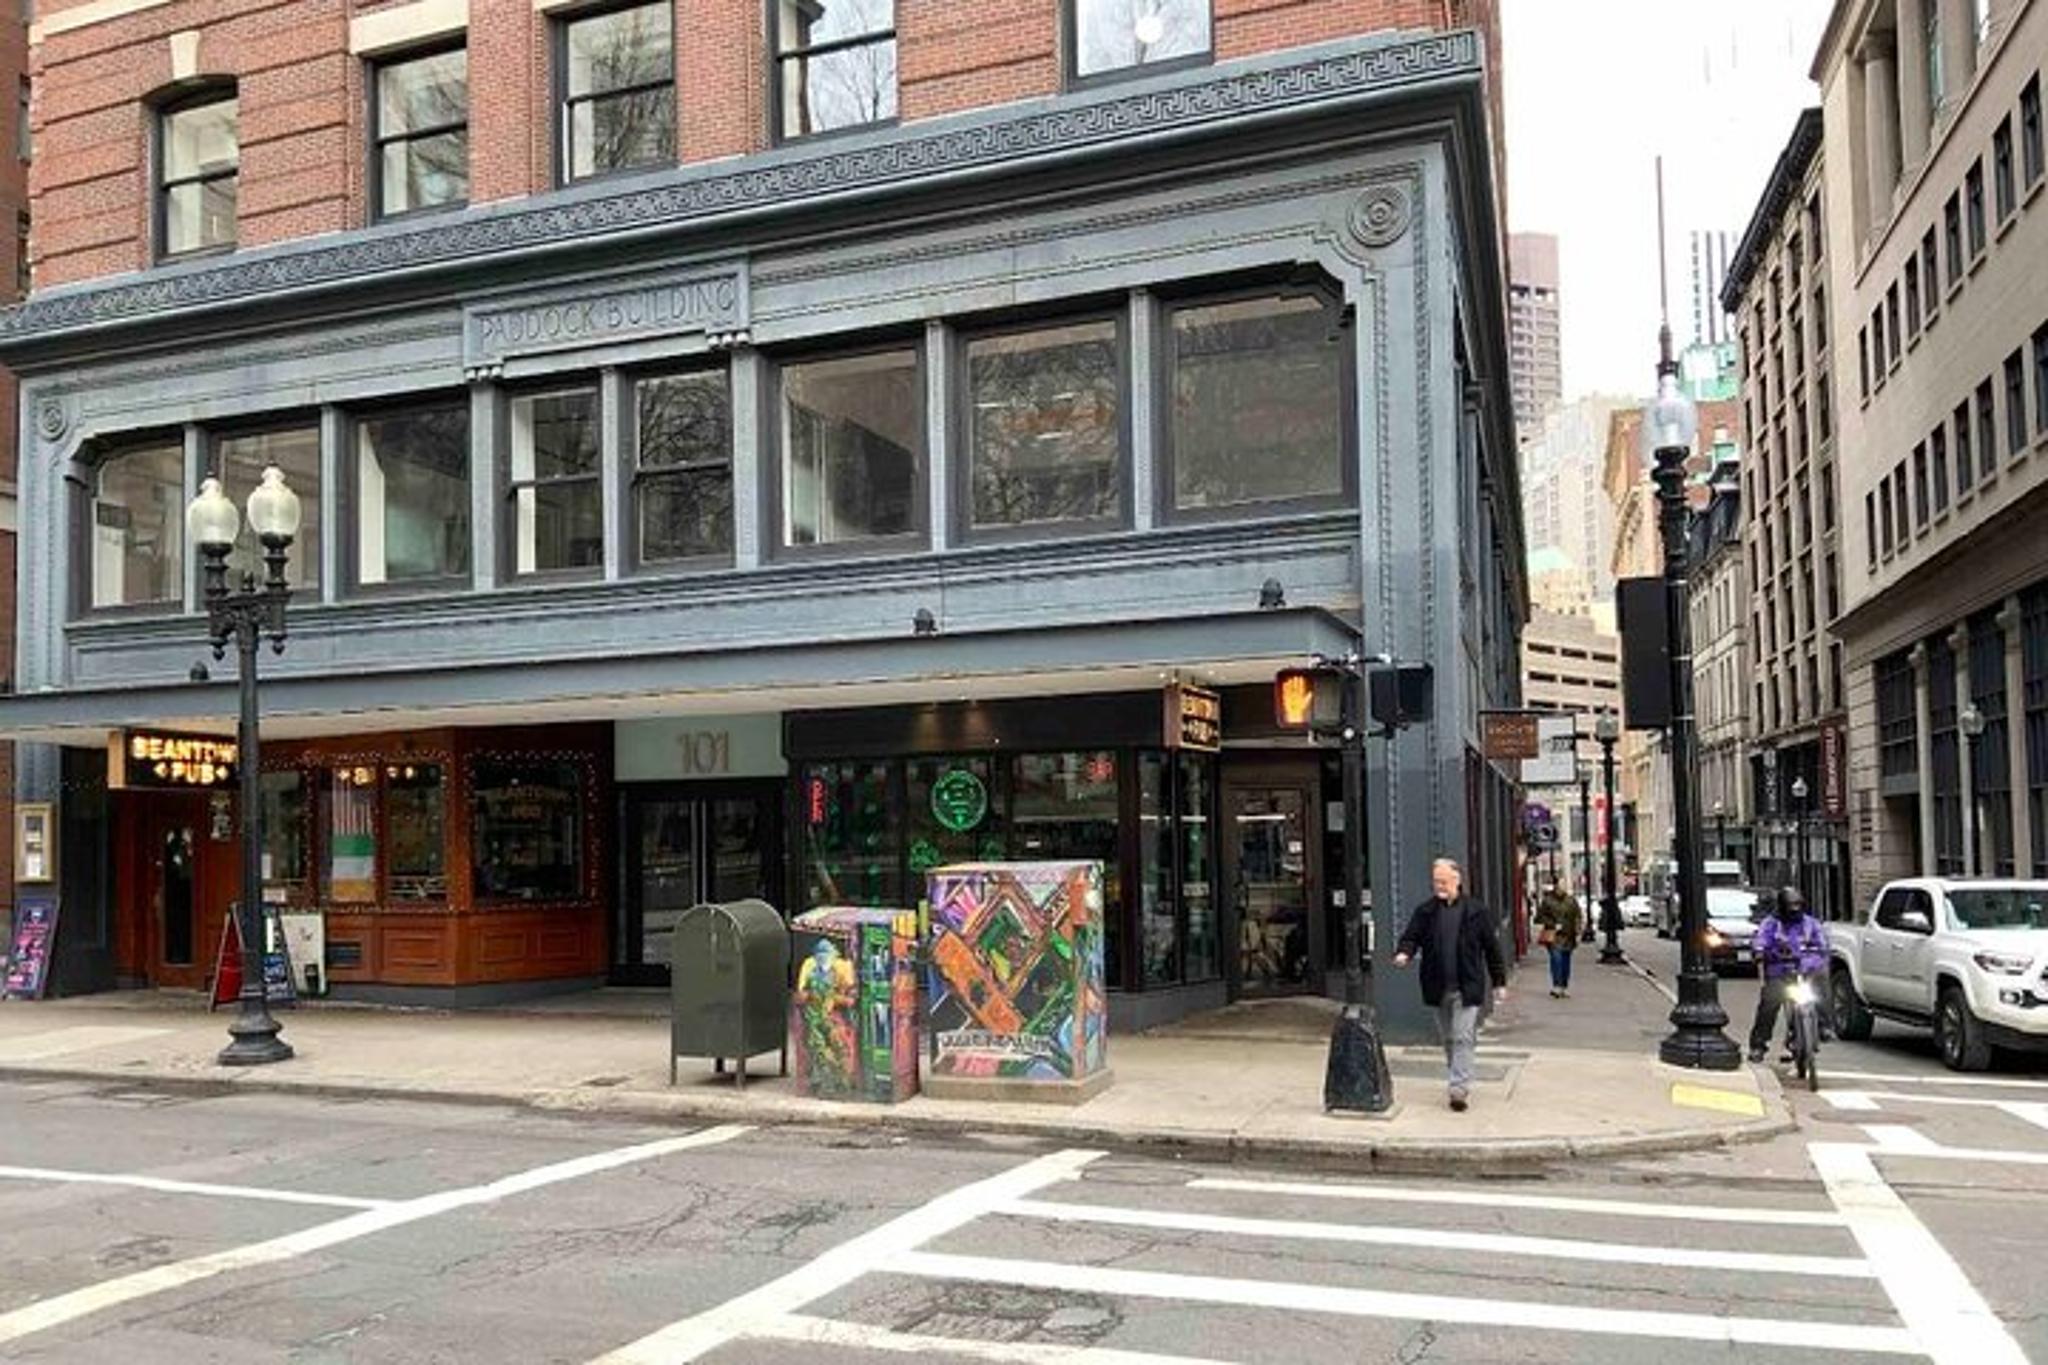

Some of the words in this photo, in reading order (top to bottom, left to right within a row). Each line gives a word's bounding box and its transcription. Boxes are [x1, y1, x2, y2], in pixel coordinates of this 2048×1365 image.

[481, 301, 596, 342] PADDOCK
[607, 281, 736, 328] BUILDING
[133, 736, 239, 763] BEANTOW
[677, 730, 730, 774] 101
[171, 761, 215, 784] PUB
